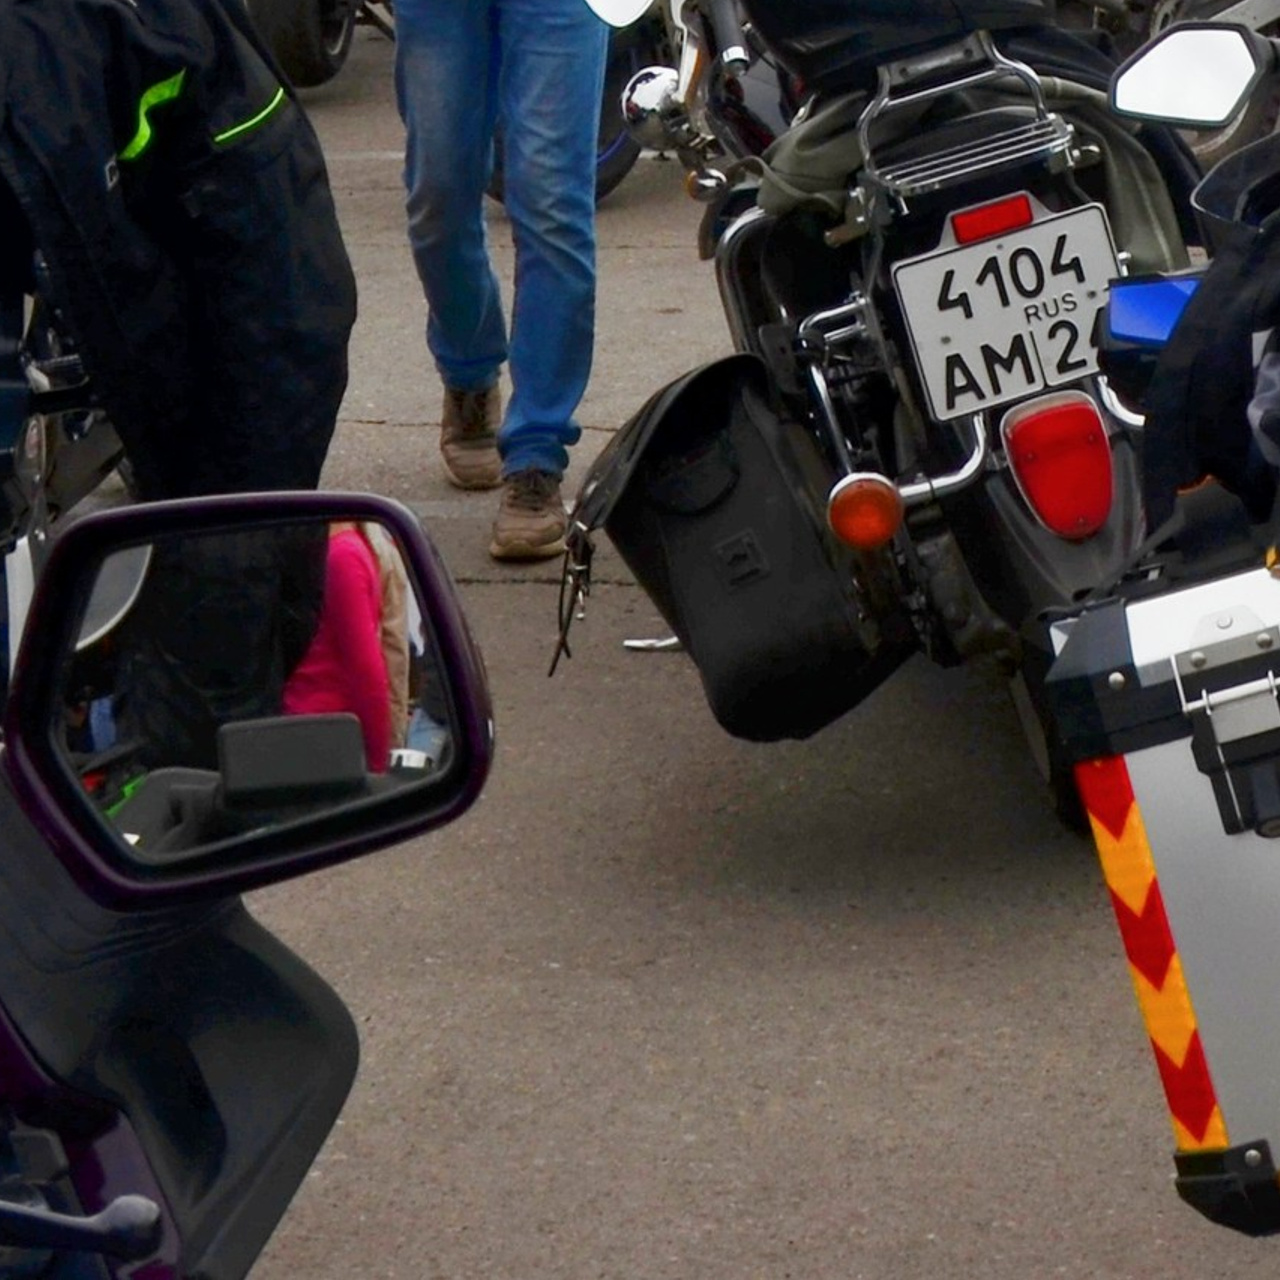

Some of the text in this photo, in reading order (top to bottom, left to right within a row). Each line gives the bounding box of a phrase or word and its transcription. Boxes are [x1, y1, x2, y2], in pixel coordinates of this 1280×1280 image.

[937, 234, 1086, 320] 4104
[1023, 292, 1078, 325] RUS
[946, 307, 1101, 411] AM 2
